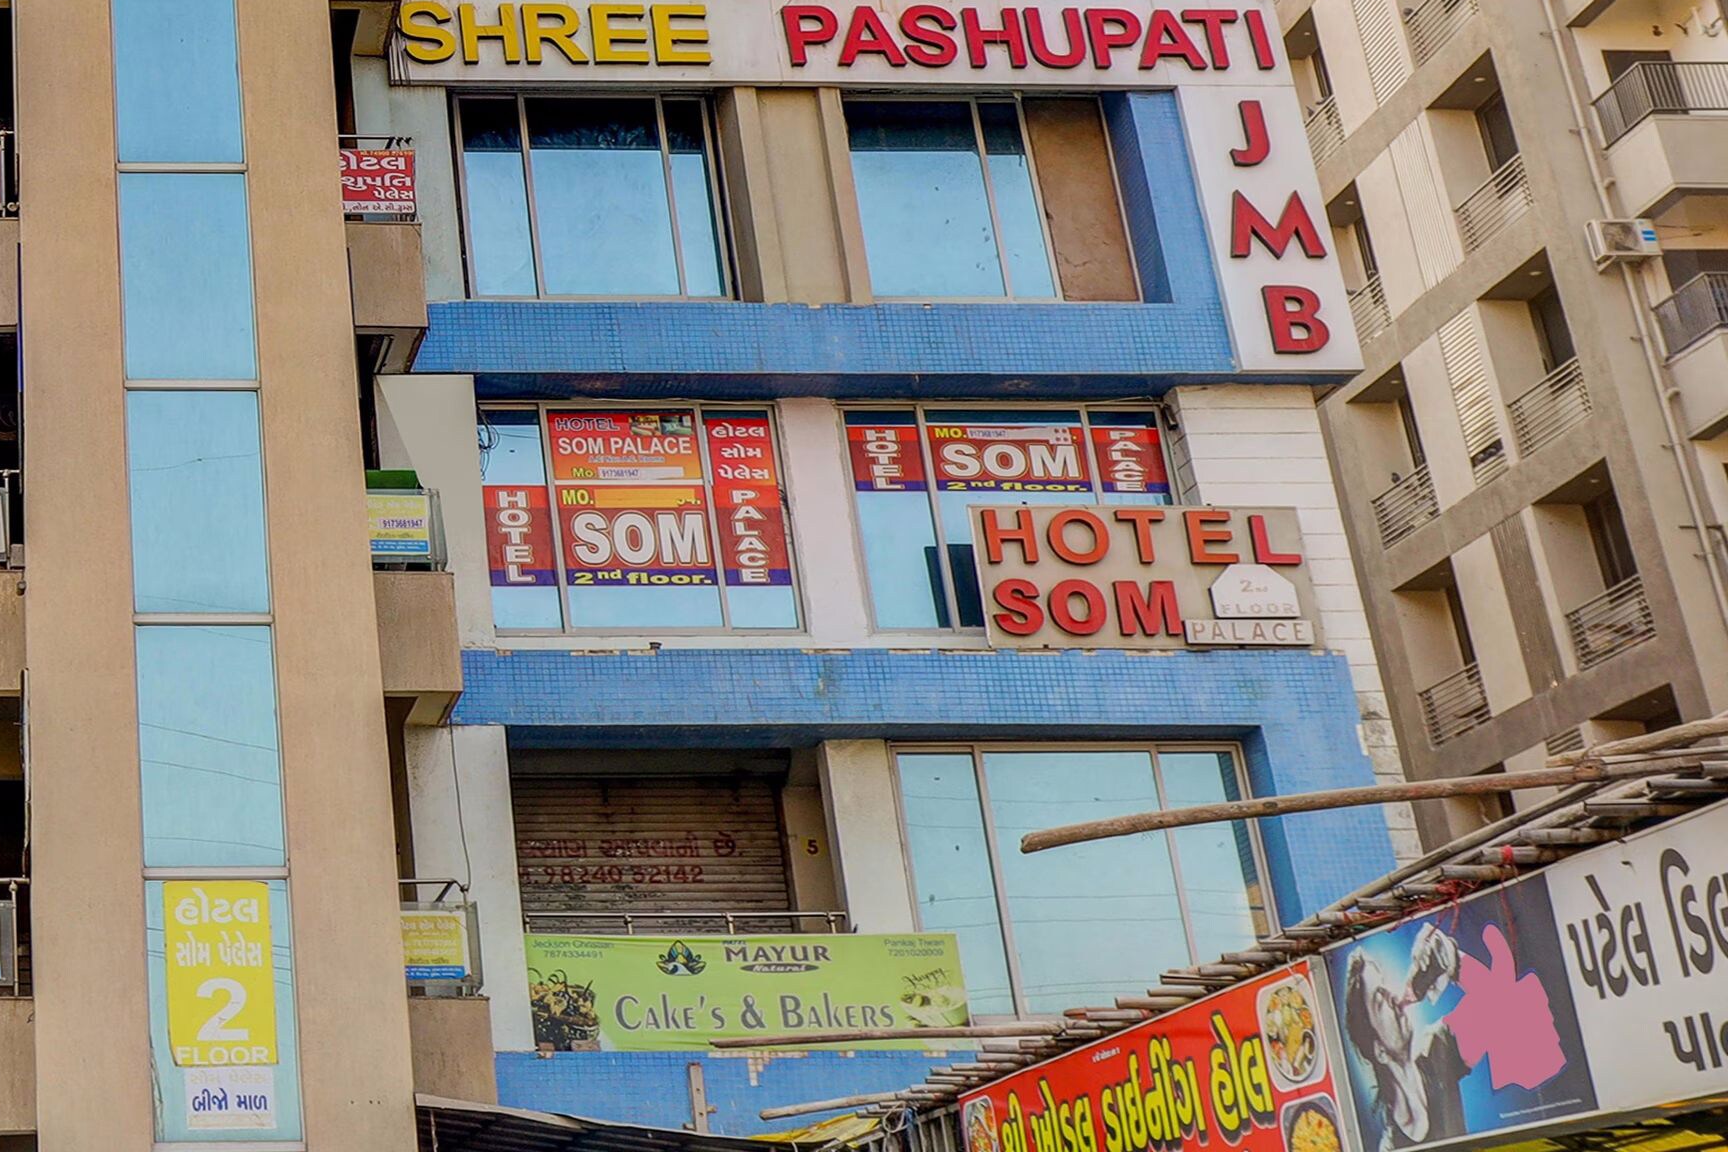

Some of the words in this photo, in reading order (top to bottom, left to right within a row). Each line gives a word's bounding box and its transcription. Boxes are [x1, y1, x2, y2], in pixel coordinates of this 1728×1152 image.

[399, 0, 712, 66] SHREE
[781, 4, 1276, 72] PASHUPATI
[1229, 100, 1330, 355] JMB
[555, 417, 620, 431] HOTEL
[712, 422, 765, 438] હોટલ
[934, 427, 967, 439] MO.
[558, 437, 604, 455] SOM
[610, 437, 692, 455] PALACE
[721, 444, 762, 459] સોમ
[864, 430, 904, 490] HOTEL
[1108, 430, 1146, 491] PALACE
[718, 465, 769, 480] પેલેસ
[942, 444, 1080, 478] SOM
[562, 489, 594, 505] MO.
[947, 481, 995, 490] 2nd
[1000, 482, 1088, 491] floor.
[496, 490, 536, 584] HOTEL
[573, 512, 709, 566] SOM
[731, 489, 771, 584] PALACE
[981, 509, 1302, 565] HOTEL
[574, 569, 621, 585] 2nd
[626, 572, 712, 585] floor.
[993, 578, 1184, 636] SOM
[1221, 603, 1298, 615] FLOOR
[1192, 622, 1306, 642] PALACE
[806, 839, 819, 855] 5
[174, 887, 260, 925] હોટલ
[175, 931, 212, 967] સોમ
[219, 931, 263, 967] પેલેસ
[1566, 874, 1660, 1000] પટેલ
[725, 945, 831, 962] MAYUR
[752, 964, 807, 972] Natural
[196, 977, 250, 1041] 2
[741, 994, 767, 1029] &
[176, 1047, 270, 1065] FLOOR
[1209, 1012, 1275, 1132] હોલ
[192, 1087, 227, 1112] બીજો
[236, 1093, 268, 1111] માળ
